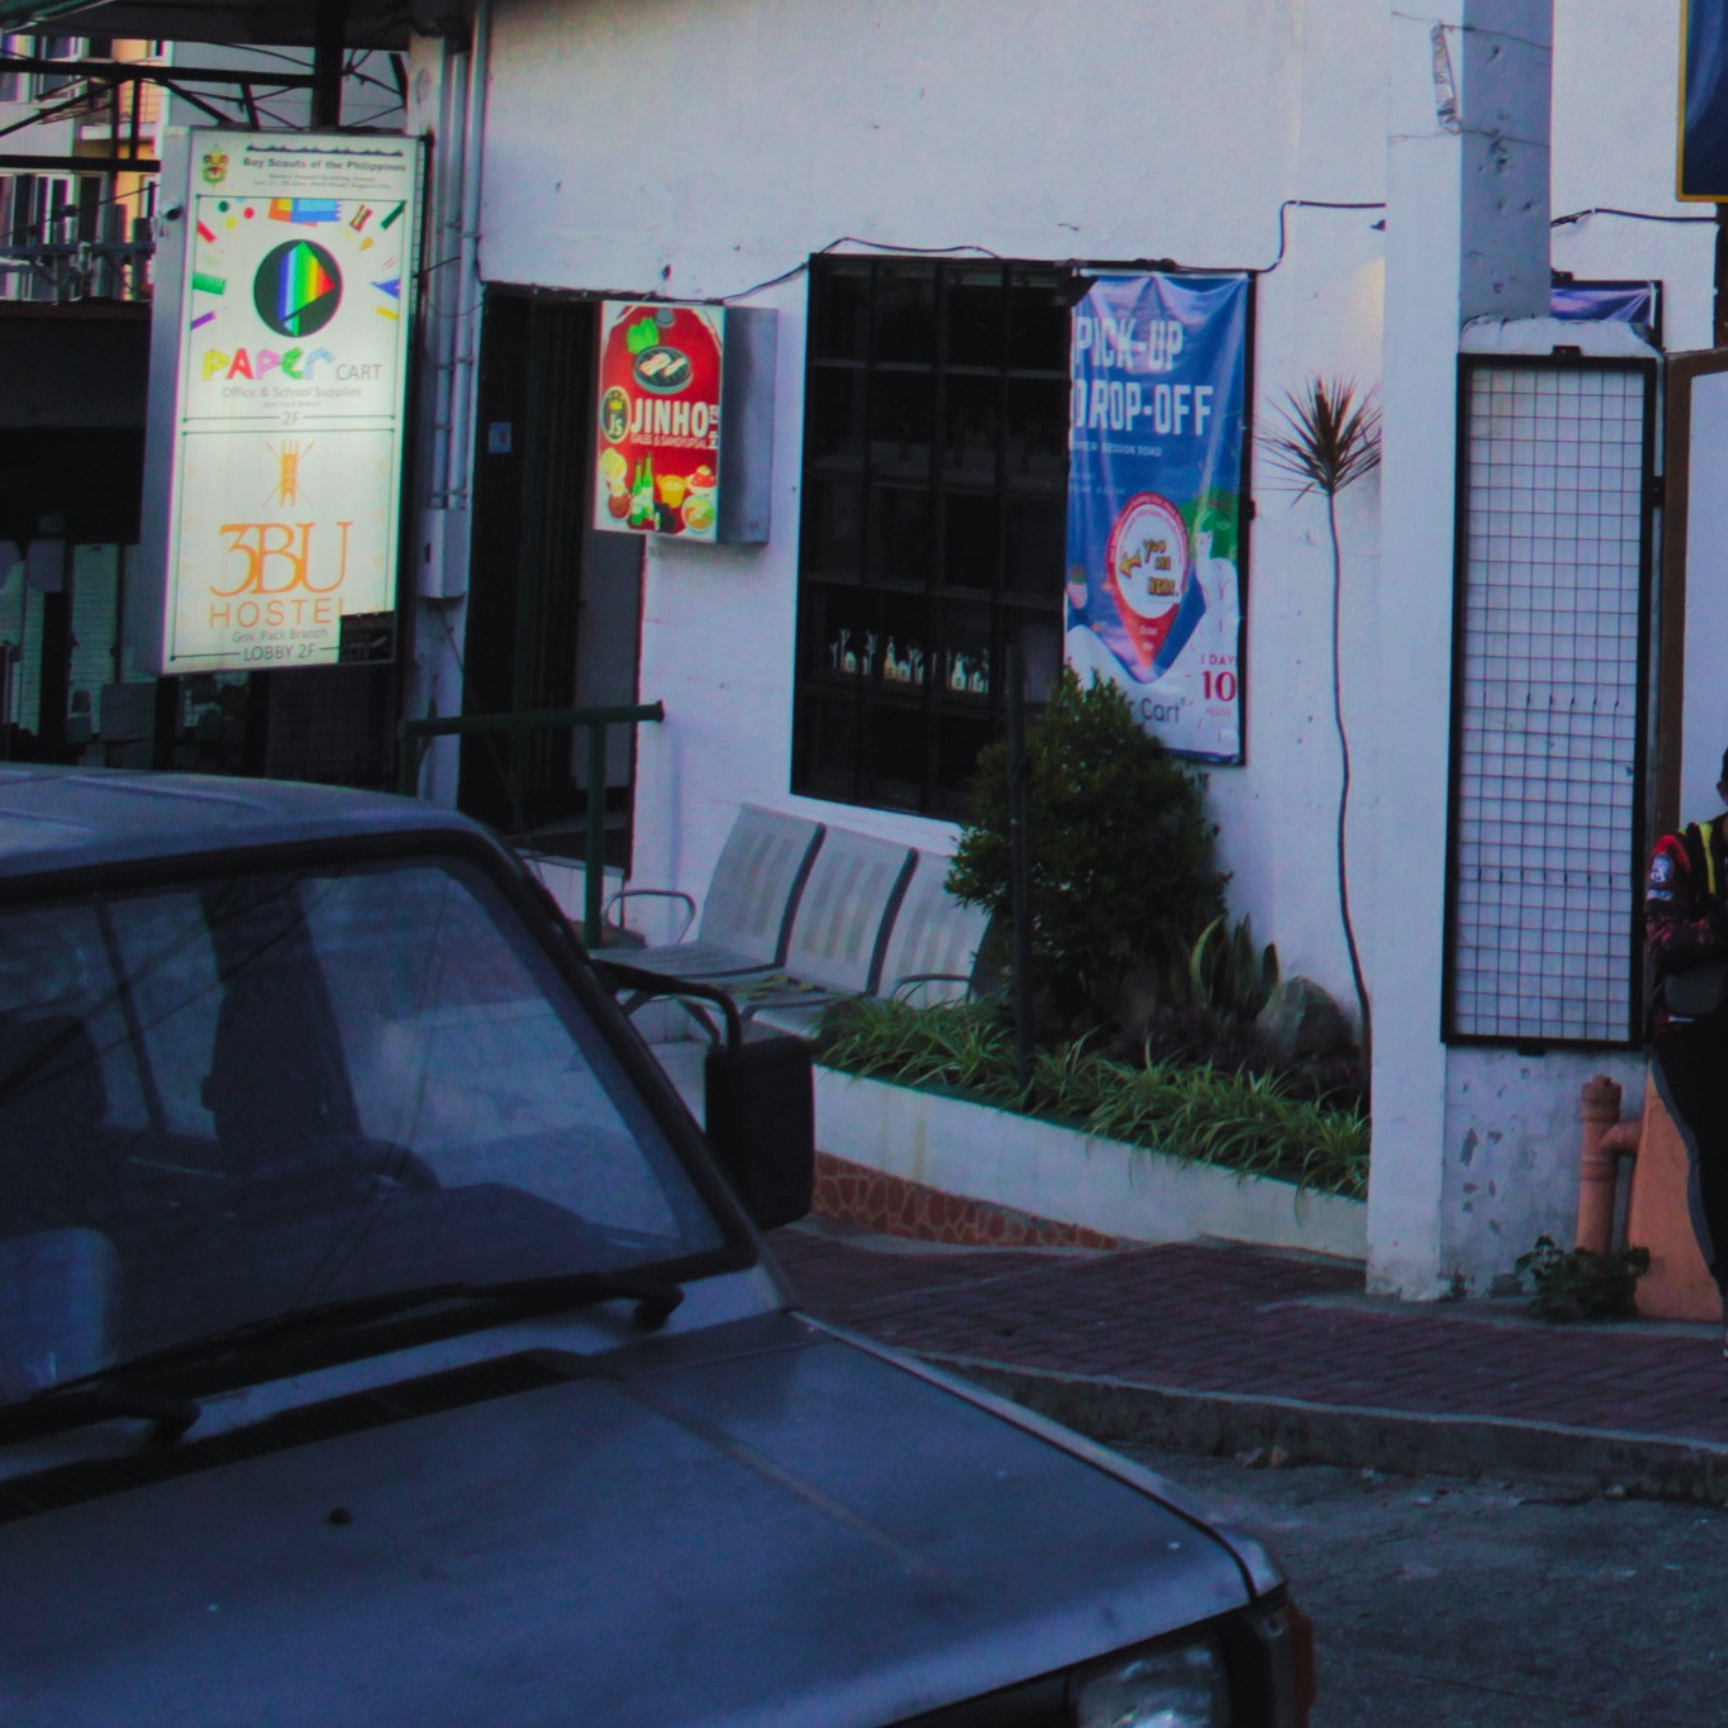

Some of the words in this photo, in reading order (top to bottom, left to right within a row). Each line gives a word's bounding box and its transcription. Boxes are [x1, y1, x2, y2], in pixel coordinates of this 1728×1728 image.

[1075, 316, 1184, 371] PICK-UP
[336, 363, 383, 380] CART
[274, 387, 313, 398] School
[315, 386, 363, 399] Supplies
[1072, 378, 1214, 436] DROP-OFF
[282, 412, 300, 426] 2F
[631, 398, 709, 438] JINHO
[209, 521, 353, 599] 3BU
[243, 644, 292, 661] LOBBY
[297, 643, 316, 658] 2F
[1201, 670, 1237, 702] 10
[1140, 697, 1181, 723] Cart
